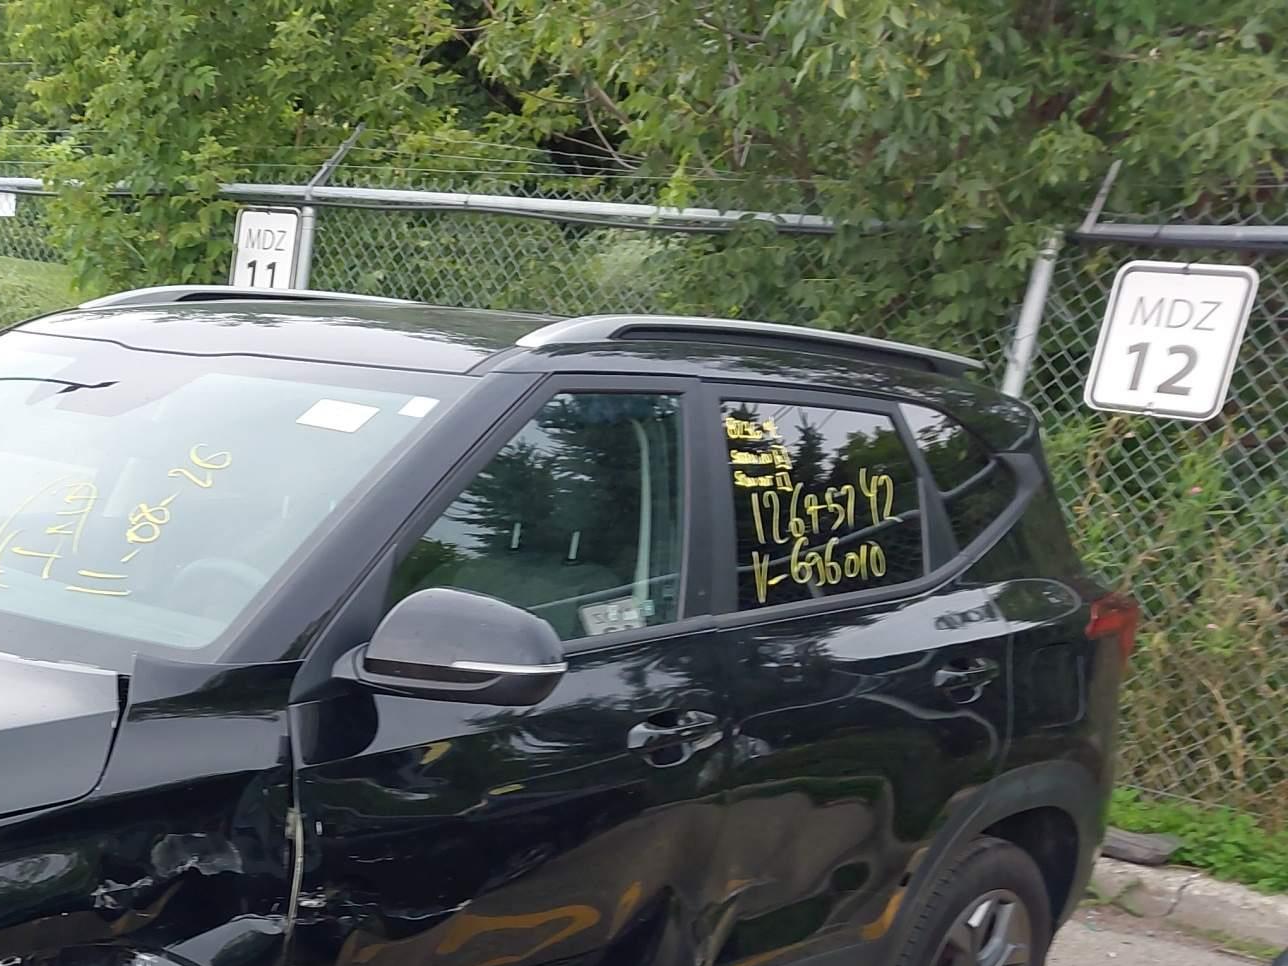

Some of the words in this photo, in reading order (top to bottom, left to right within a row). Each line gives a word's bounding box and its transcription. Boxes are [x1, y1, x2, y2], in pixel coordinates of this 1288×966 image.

[245, 228, 288, 252] MDZ
[247, 259, 280, 288] 11
[1128, 295, 1224, 332] MDZ
[1126, 341, 1199, 397] 12
